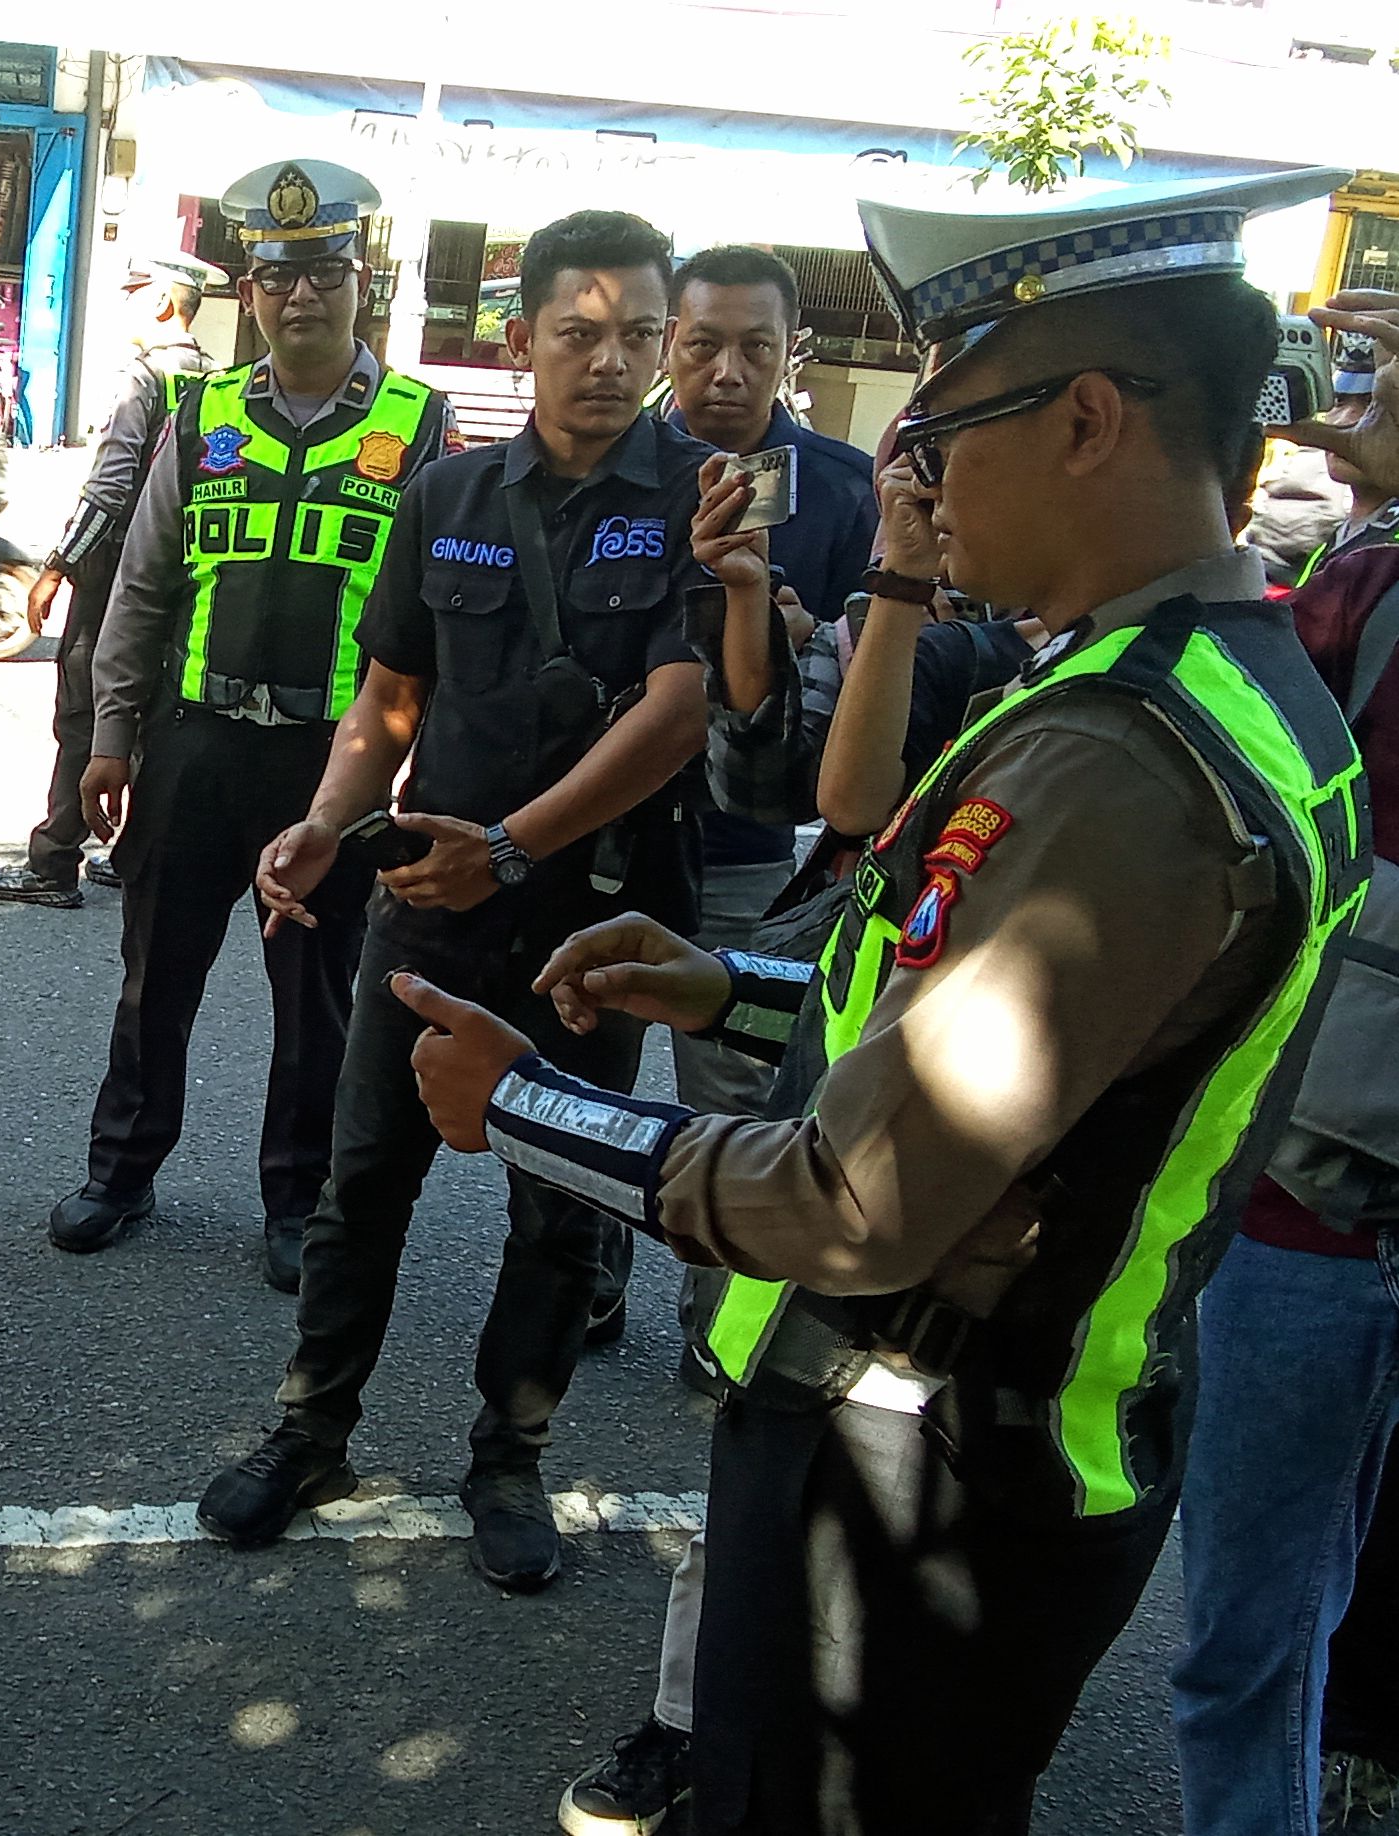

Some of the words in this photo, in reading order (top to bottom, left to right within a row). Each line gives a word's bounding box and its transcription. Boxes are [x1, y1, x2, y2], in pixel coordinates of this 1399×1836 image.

[193, 480, 243, 499] HANI.R
[344, 479, 399, 507] POLRI
[431, 538, 514, 568] GINUNG
[950, 803, 1001, 831] LRES
